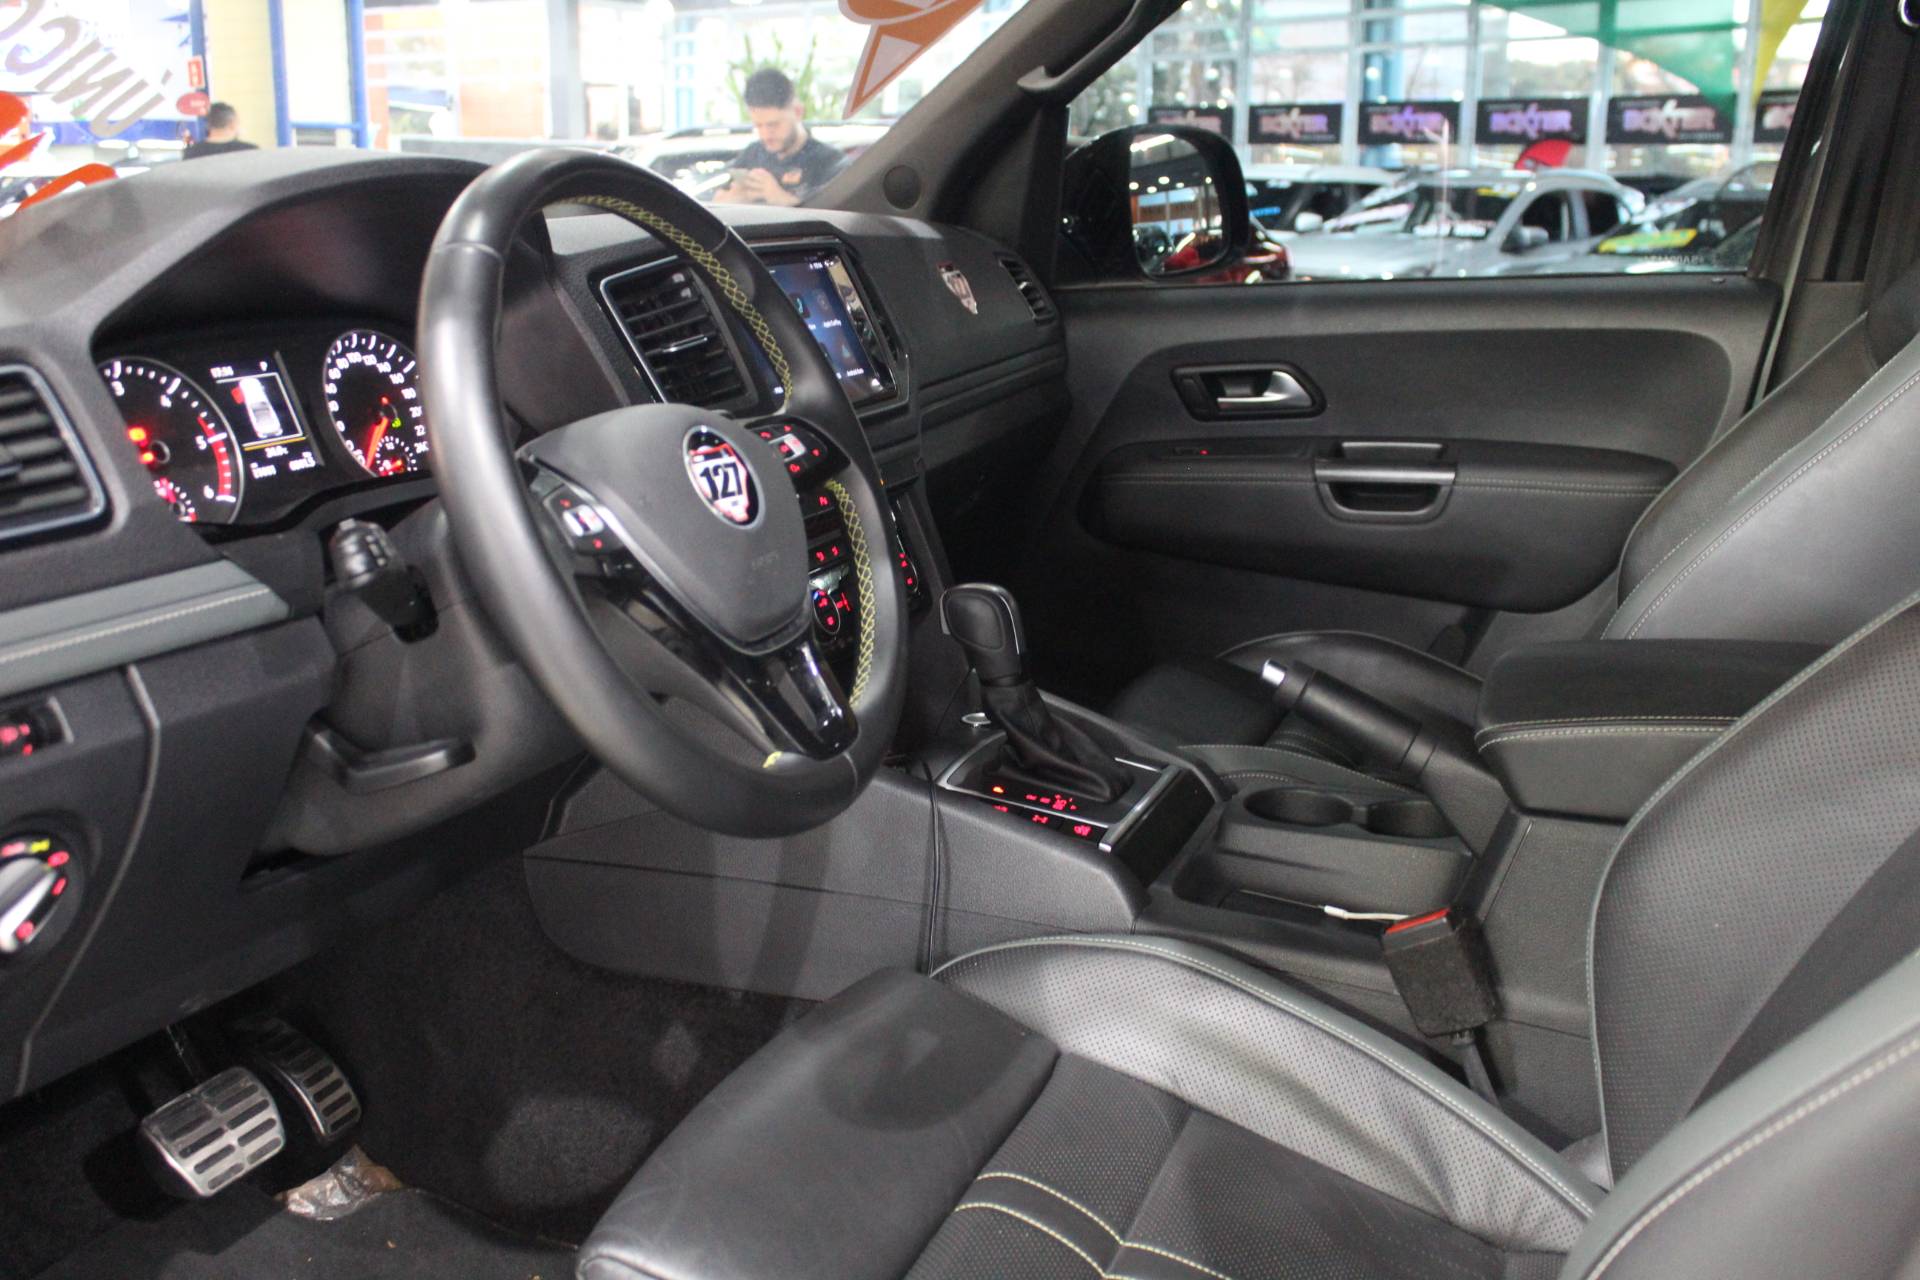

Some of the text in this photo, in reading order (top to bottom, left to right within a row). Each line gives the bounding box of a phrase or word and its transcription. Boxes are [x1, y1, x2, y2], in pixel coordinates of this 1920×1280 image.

[195, 435, 207, 450] 5
[700, 462, 743, 501] 127
[203, 485, 215, 499] 6
